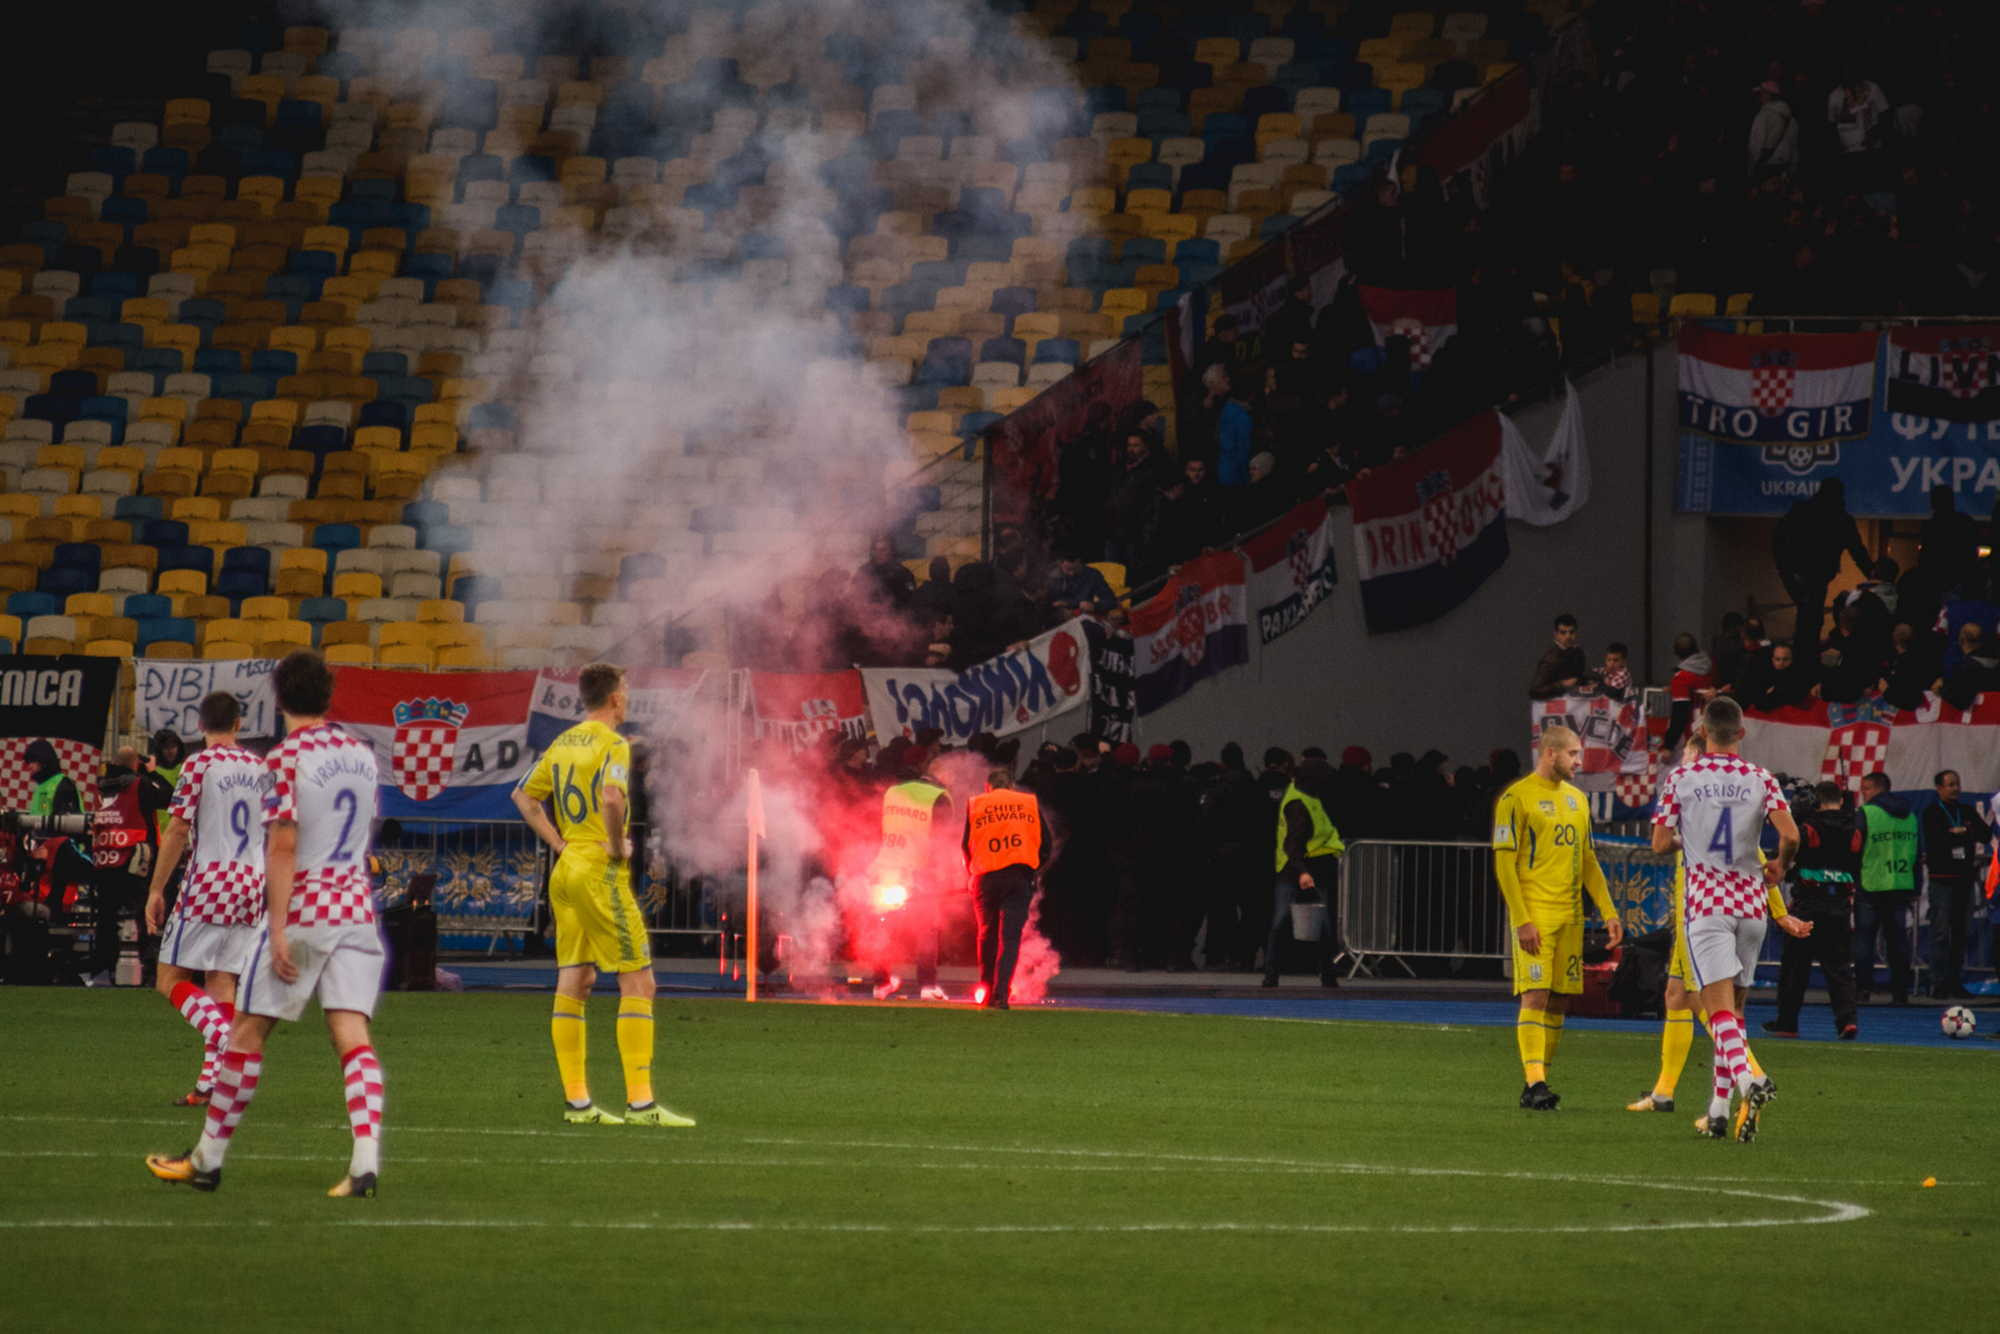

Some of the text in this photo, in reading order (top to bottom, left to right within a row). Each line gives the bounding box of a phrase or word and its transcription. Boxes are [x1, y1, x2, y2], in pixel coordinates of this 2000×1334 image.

[0, 669, 83, 706] NICA
[552, 763, 588, 824] 16
[984, 804, 1024, 815] CHIEF
[231, 800, 250, 859] 9
[328, 788, 358, 862] 2
[975, 811, 1036, 829] STEWARD
[1554, 823, 1577, 847] 20
[1707, 806, 1734, 866] 4
[989, 834, 1023, 853] 016
